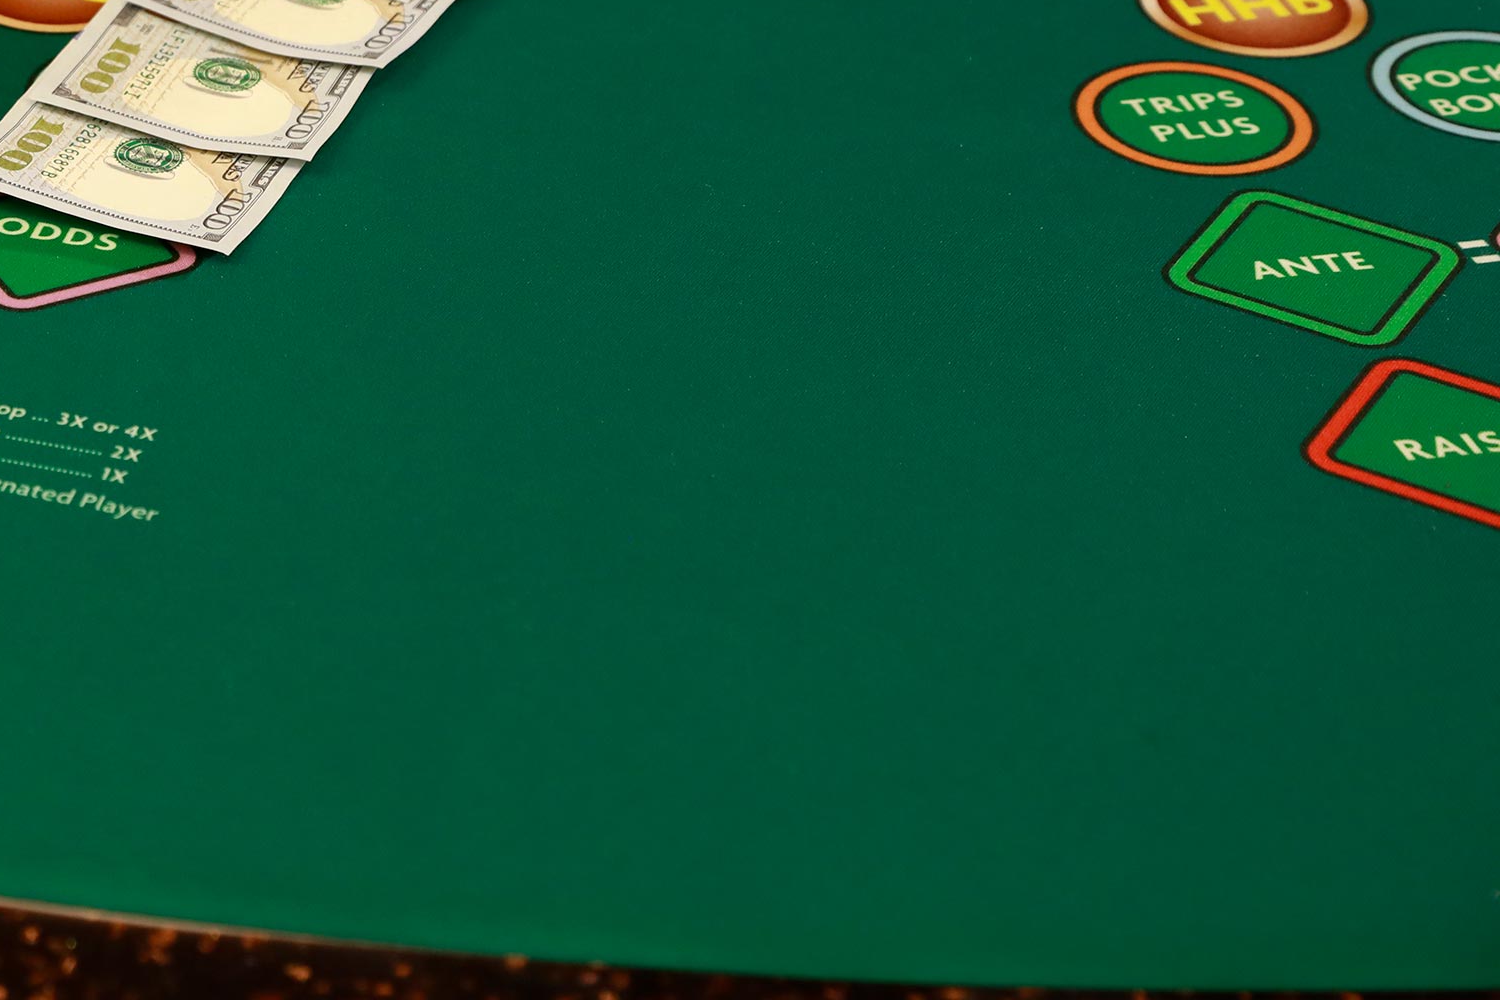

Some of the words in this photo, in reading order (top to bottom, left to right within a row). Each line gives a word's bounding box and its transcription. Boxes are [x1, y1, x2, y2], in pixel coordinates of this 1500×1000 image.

[364, 11, 415, 50] 100
[79, 36, 144, 95] 100
[1120, 89, 1245, 117] TRIPS
[285, 99, 332, 140] 100
[1149, 116, 1261, 143] PLUS
[201, 187, 254, 231] 100
[1254, 250, 1375, 281] ANTE
[56, 412, 88, 430] 3X
[92, 418, 120, 434] or
[124, 424, 159, 442] 4X
[109, 444, 143, 463] 2X
[100, 466, 129, 485] 1X
[79, 491, 160, 522] Player
